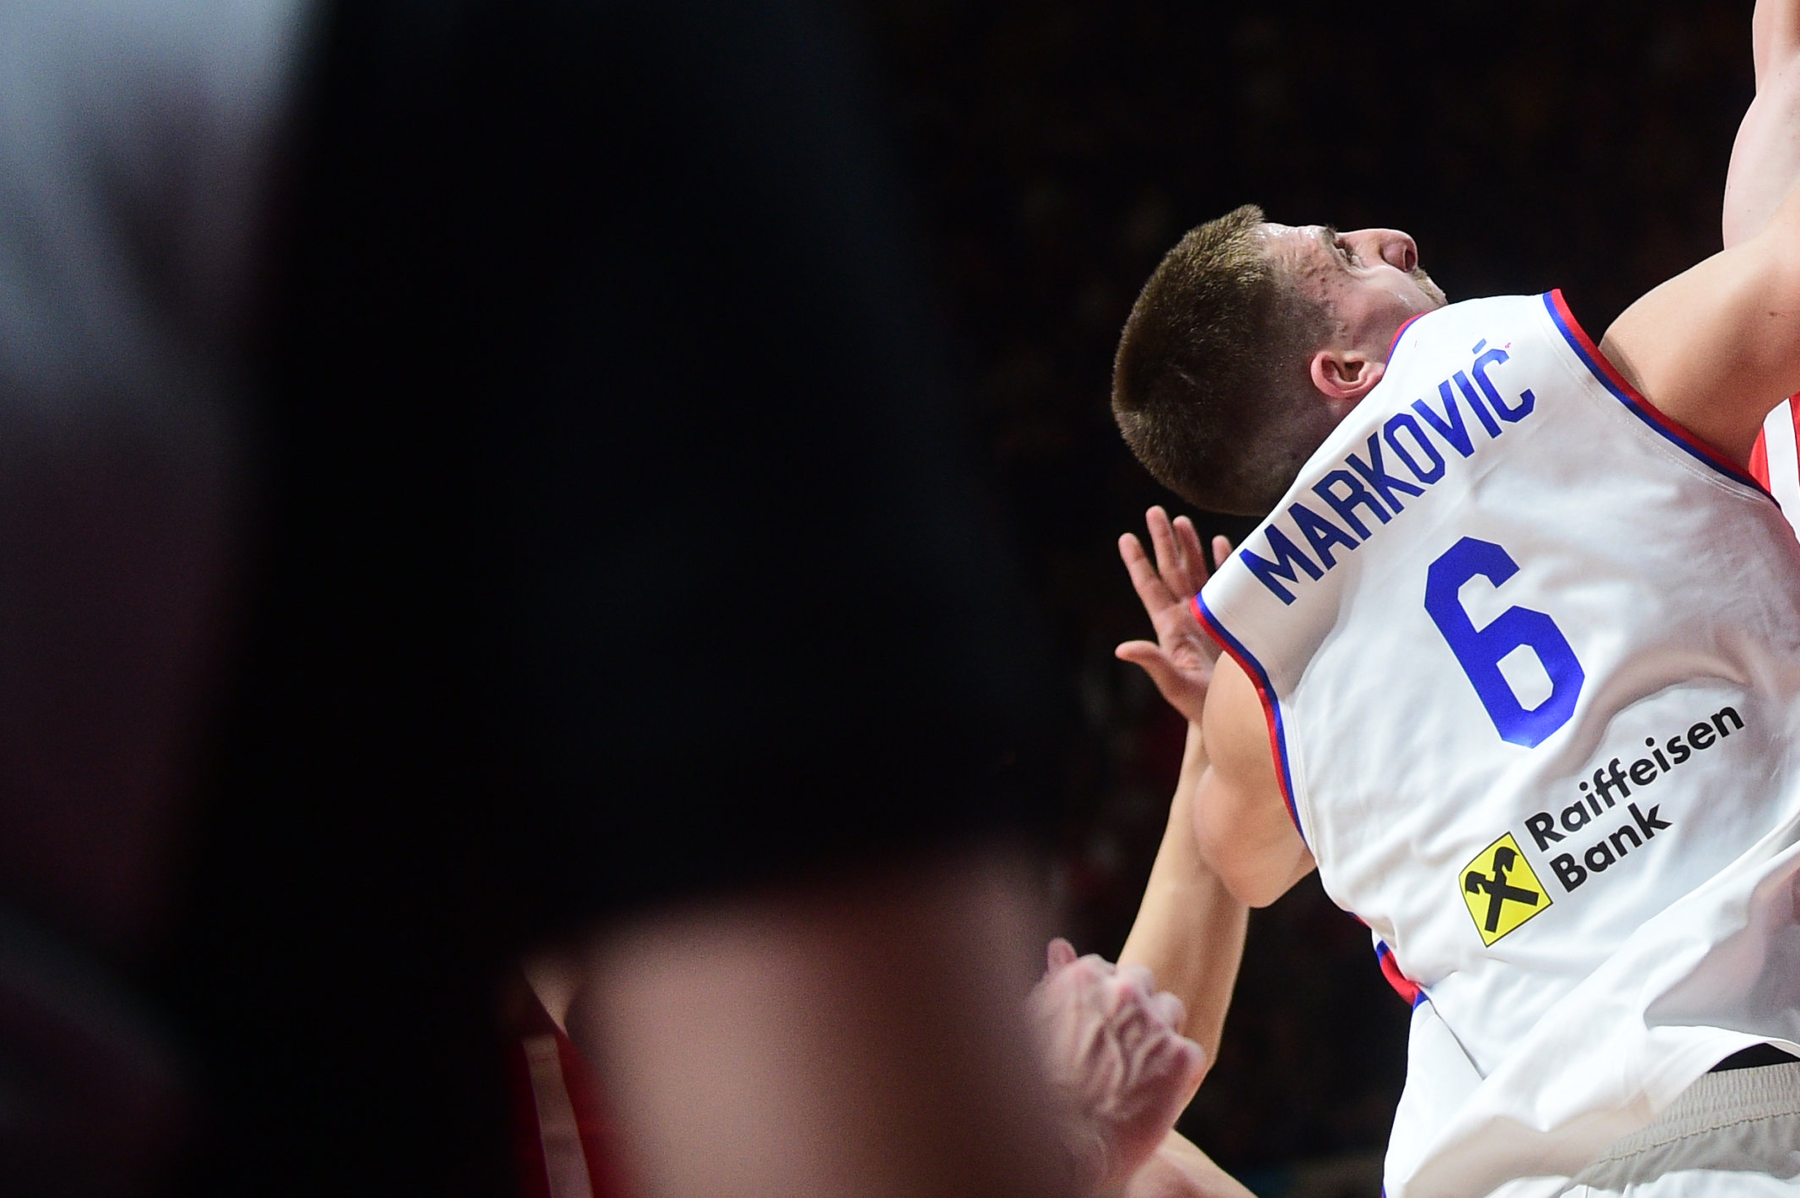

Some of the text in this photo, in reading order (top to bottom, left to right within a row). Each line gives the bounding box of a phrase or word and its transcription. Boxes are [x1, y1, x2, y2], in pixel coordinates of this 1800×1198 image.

[1238, 339, 1536, 606] MARKOVIĆ
[1424, 536, 1585, 749] 6
[1524, 706, 1745, 853] Raiffeisen
[1549, 798, 1673, 893] Bank
